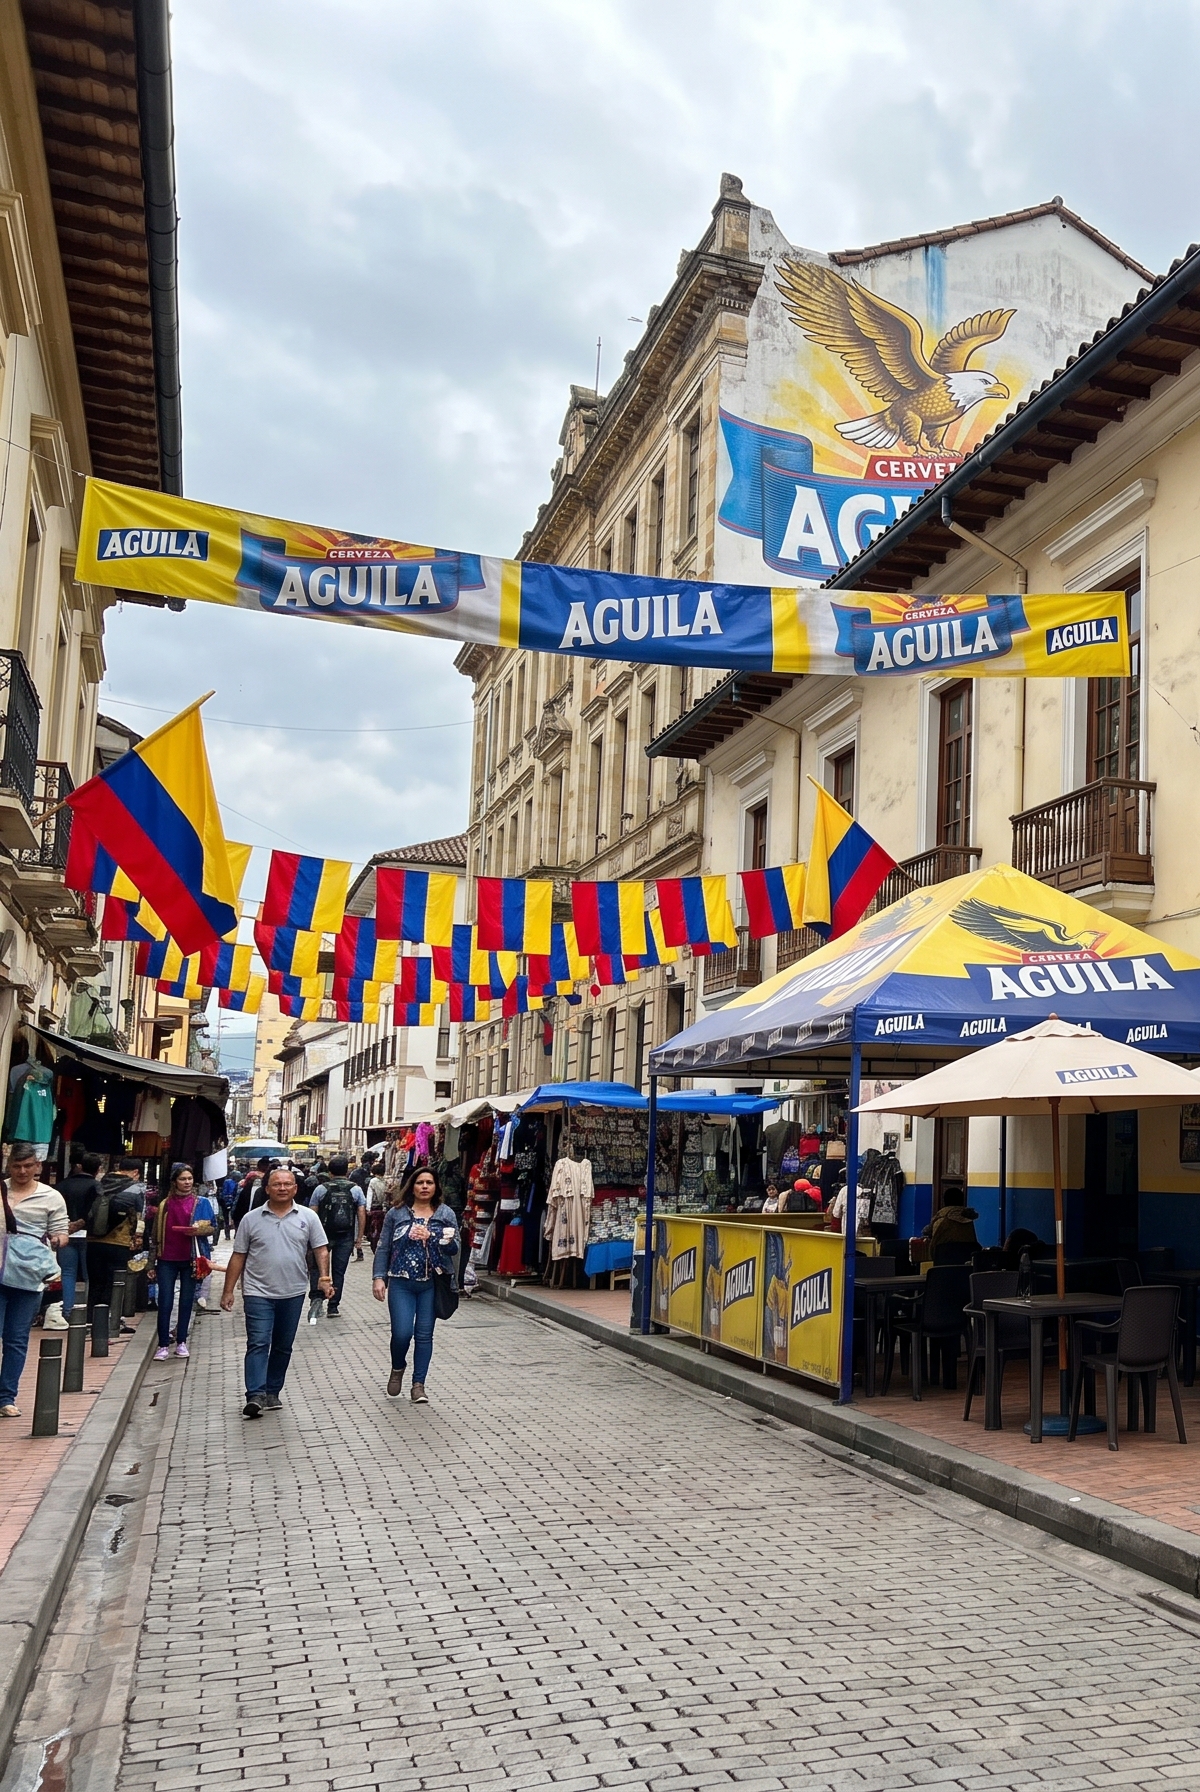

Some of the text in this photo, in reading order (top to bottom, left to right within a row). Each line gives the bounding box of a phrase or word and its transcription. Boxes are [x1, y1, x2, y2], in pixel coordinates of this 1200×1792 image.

[101, 530, 203, 559] AGUILA
[329, 550, 391, 559] CERVEZA
[273, 564, 442, 608] AGUILA
[558, 591, 723, 649] AGUILA
[905, 606, 955, 621] CERVEZA
[866, 614, 999, 672] AGUILA
[1050, 619, 1115, 654] AGUILA
[985, 957, 1176, 1001] AGUILA
[874, 1013, 925, 1036] AGUILA
[1064, 1065, 1133, 1084] AGUILA
[724, 1260, 753, 1307] AGUILA
[793, 1271, 830, 1325] AGUILA
